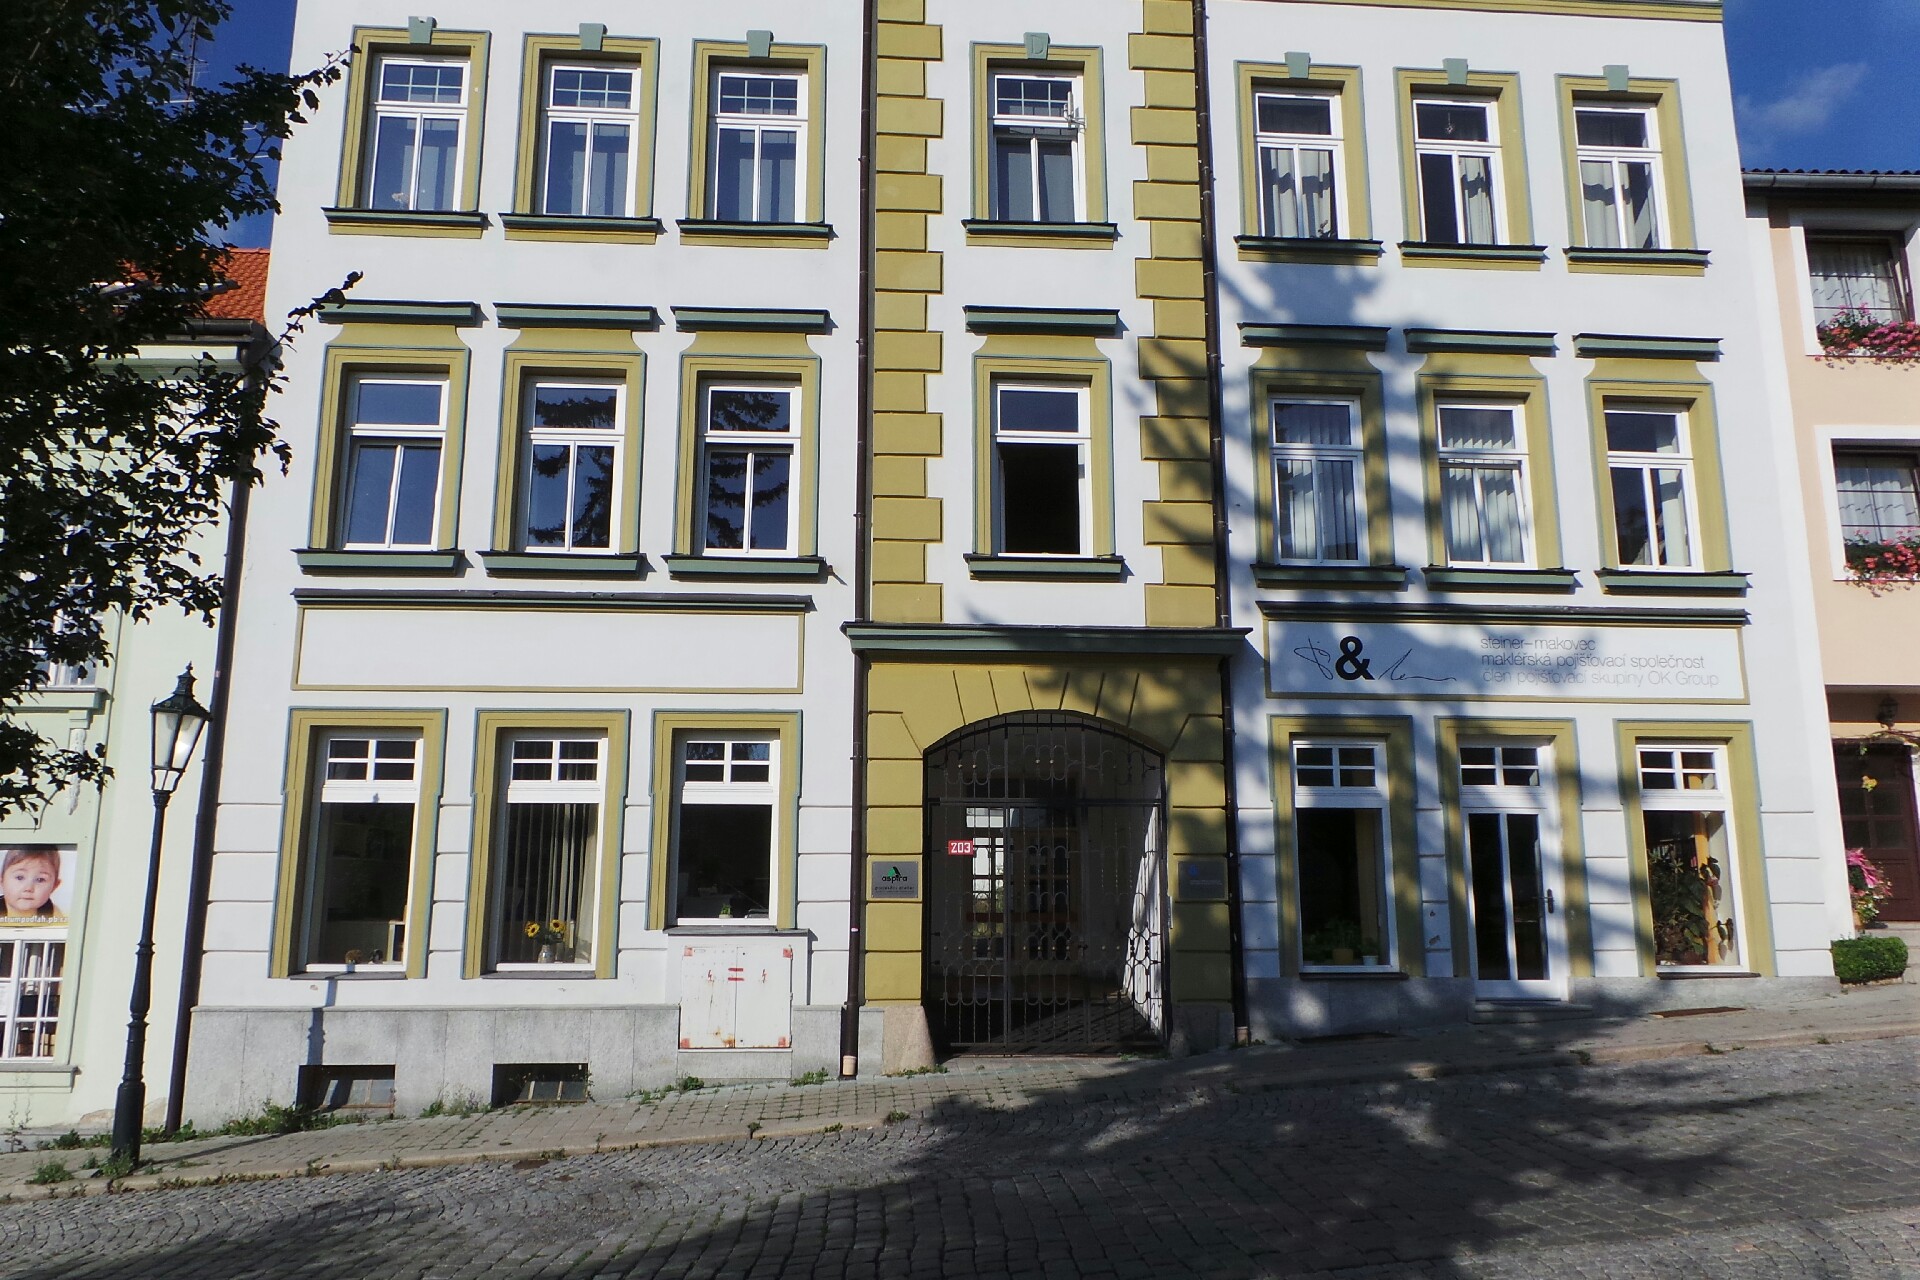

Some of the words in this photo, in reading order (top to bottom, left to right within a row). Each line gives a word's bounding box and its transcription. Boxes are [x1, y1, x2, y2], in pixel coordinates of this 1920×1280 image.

[1335, 635, 1375, 681] &
[1481, 652, 1552, 667] makléřská
[1630, 654, 1705, 670] společnost
[1591, 670, 1644, 688] skupiny
[1647, 670, 1673, 685] OK
[1675, 671, 1720, 688] Group
[950, 842, 971, 853] 203
[881, 874, 908, 884] aspira
